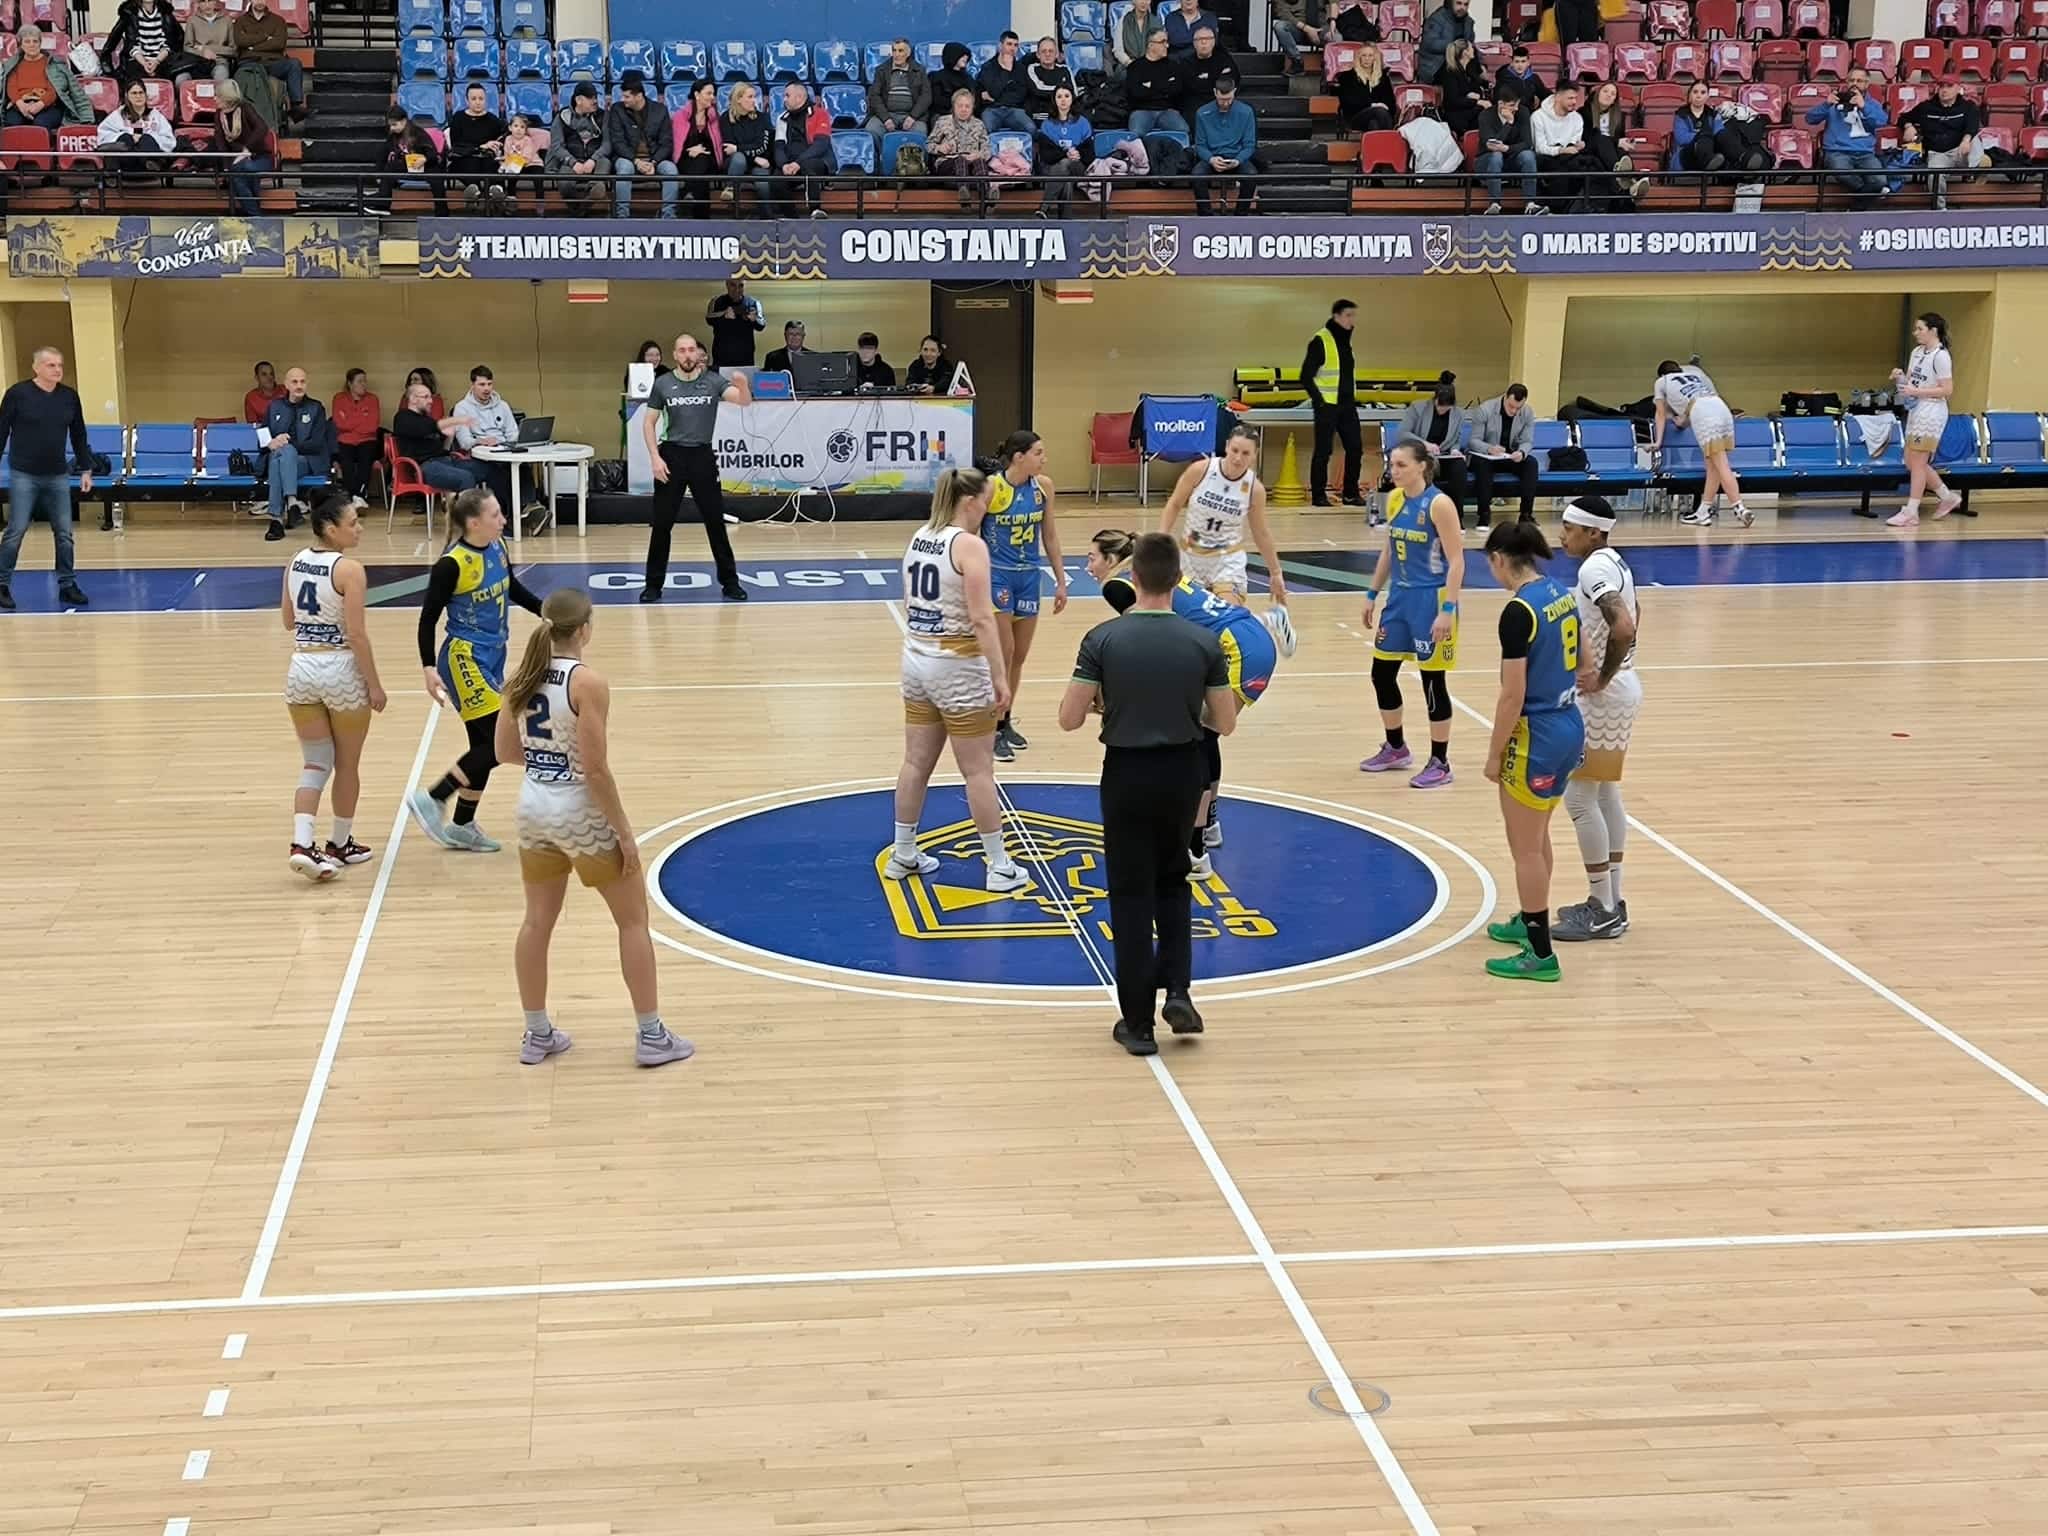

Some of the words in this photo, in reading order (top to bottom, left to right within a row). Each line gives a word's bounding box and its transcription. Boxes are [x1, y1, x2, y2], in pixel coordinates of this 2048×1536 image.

[60, 136, 98, 152] PRES
[174, 221, 214, 246] Visit
[1521, 233, 1538, 255] O
[1542, 233, 1610, 254] MARE
[1614, 233, 1643, 254] DE
[1647, 231, 1757, 254] SPORTIVI
[457, 235, 741, 262] #TEAMISEVERYTHING
[841, 229, 1067, 268] CONSTANȚA
[1192, 235, 1253, 259] CSM
[1258, 235, 1413, 263] CONSTANȚA
[1154, 419, 1206, 433] molten
[866, 431, 946, 462] FRH
[1010, 524, 1035, 545] 24
[1206, 518, 1223, 531] 11
[1396, 540, 1407, 561] 9
[908, 561, 940, 601] 10
[297, 580, 321, 615] 4
[1561, 615, 1578, 672] 8
[527, 693, 552, 739] 2
